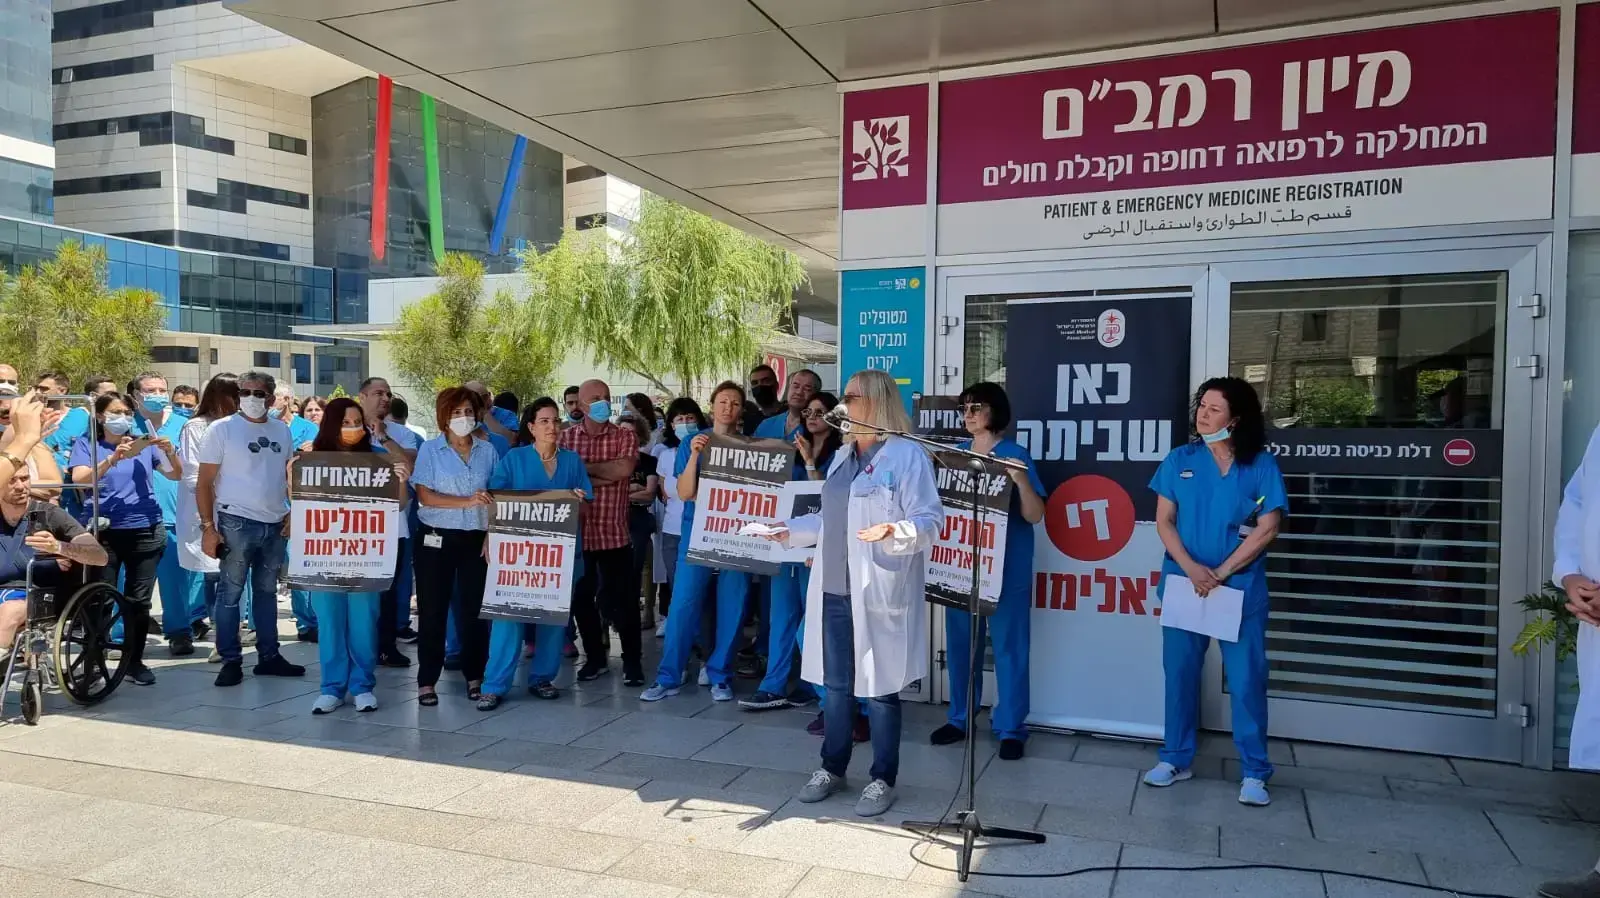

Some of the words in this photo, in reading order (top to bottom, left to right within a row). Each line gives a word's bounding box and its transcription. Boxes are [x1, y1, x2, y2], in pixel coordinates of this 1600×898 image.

[1281, 50, 1412, 132] מיון
[1236, 130, 1344, 165] לרפואה
[1355, 121, 1488, 159] המחלקה
[1055, 154, 1133, 182] וקבלת
[1143, 145, 1226, 174] דחופה
[983, 160, 1047, 187] חולים
[1044, 201, 1098, 219] PATIENT
[1102, 200, 1111, 215] &
[1116, 192, 1203, 214] EMERGENCY
[1208, 186, 1281, 207] MEDICINE
[1286, 177, 1403, 202] REGISTRATION
[1133, 215, 1203, 236] واستقبال
[1206, 211, 1267, 231] الطوارئ
[1307, 206, 1352, 226] قسم
[1082, 220, 1130, 240] المرضى
[859, 309, 908, 326] מטופלים
[859, 333, 907, 350] ומבקרים
[866, 355, 899, 372] יקרים
[1055, 363, 1132, 412] כאן
[1015, 419, 1172, 462] שביתה
[1294, 444, 1341, 458] בשבת
[1345, 444, 1392, 458] כניסה
[1396, 443, 1432, 458] דלת
[707, 446, 787, 473] #האחיות
[300, 466, 392, 488] #האחיות
[495, 501, 572, 523] #האחיות
[707, 487, 778, 519] החליטו
[305, 507, 385, 534] החליטו
[1065, 499, 1111, 541] די
[303, 538, 368, 556] לאלימות
[371, 539, 385, 556] די
[498, 540, 564, 568] החליטו
[930, 545, 976, 570] אלימות
[982, 556, 994, 575] די
[496, 569, 548, 589] לאלימות
[550, 573, 562, 589] די
[1030, 568, 1162, 616] אלימו
